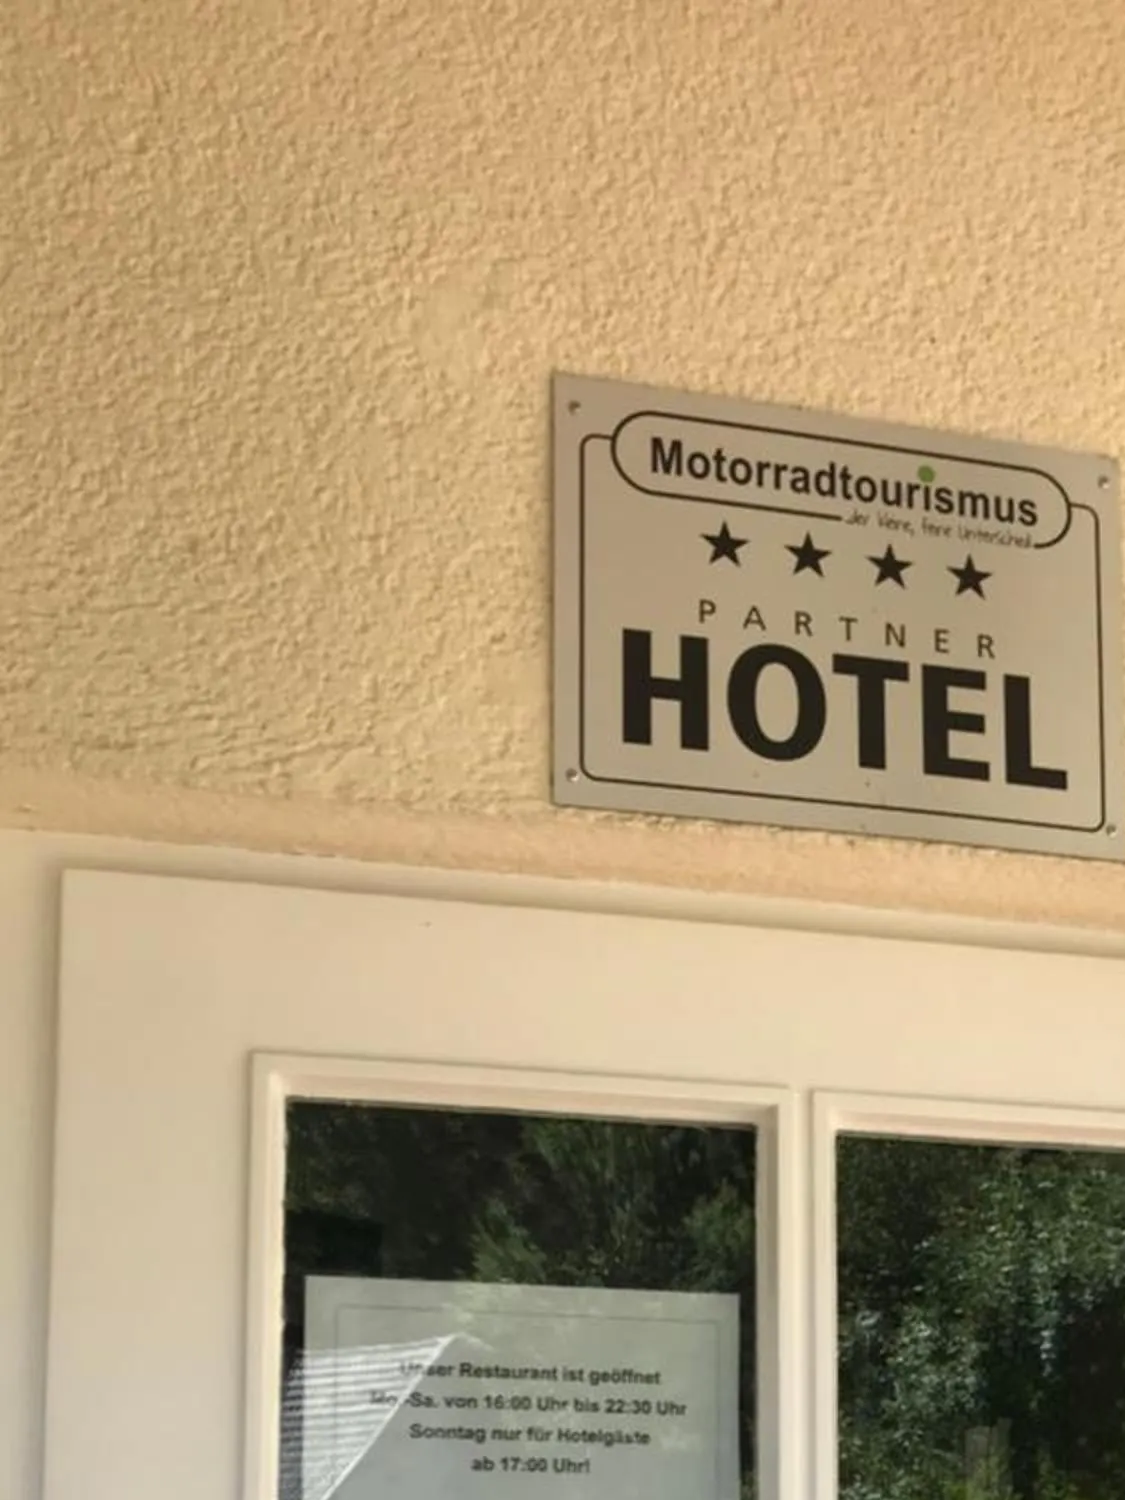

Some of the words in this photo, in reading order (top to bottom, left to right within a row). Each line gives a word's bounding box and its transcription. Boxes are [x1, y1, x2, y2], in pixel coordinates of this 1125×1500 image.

[650, 436, 1038, 527] Motorradtourismus
[699, 600, 996, 659] PARTNER
[622, 628, 1068, 790] HOTEL
[459, 1362, 557, 1381] Restaurant
[562, 1366, 584, 1382] ist
[589, 1368, 661, 1386] geöffnet
[444, 1396, 478, 1409] von
[485, 1395, 532, 1411] 16:00
[536, 1397, 568, 1412] Uhr
[573, 1398, 599, 1413] bis
[605, 1398, 652, 1415] 22:30
[656, 1400, 687, 1416] Uhr
[409, 1423, 486, 1444] Sonntag
[491, 1428, 522, 1441] nur
[526, 1426, 552, 1442] für
[557, 1428, 651, 1447] Hotelgäste
[471, 1456, 495, 1472] ab
[501, 1456, 548, 1473] 17:00
[553, 1457, 590, 1474] Uhr!
